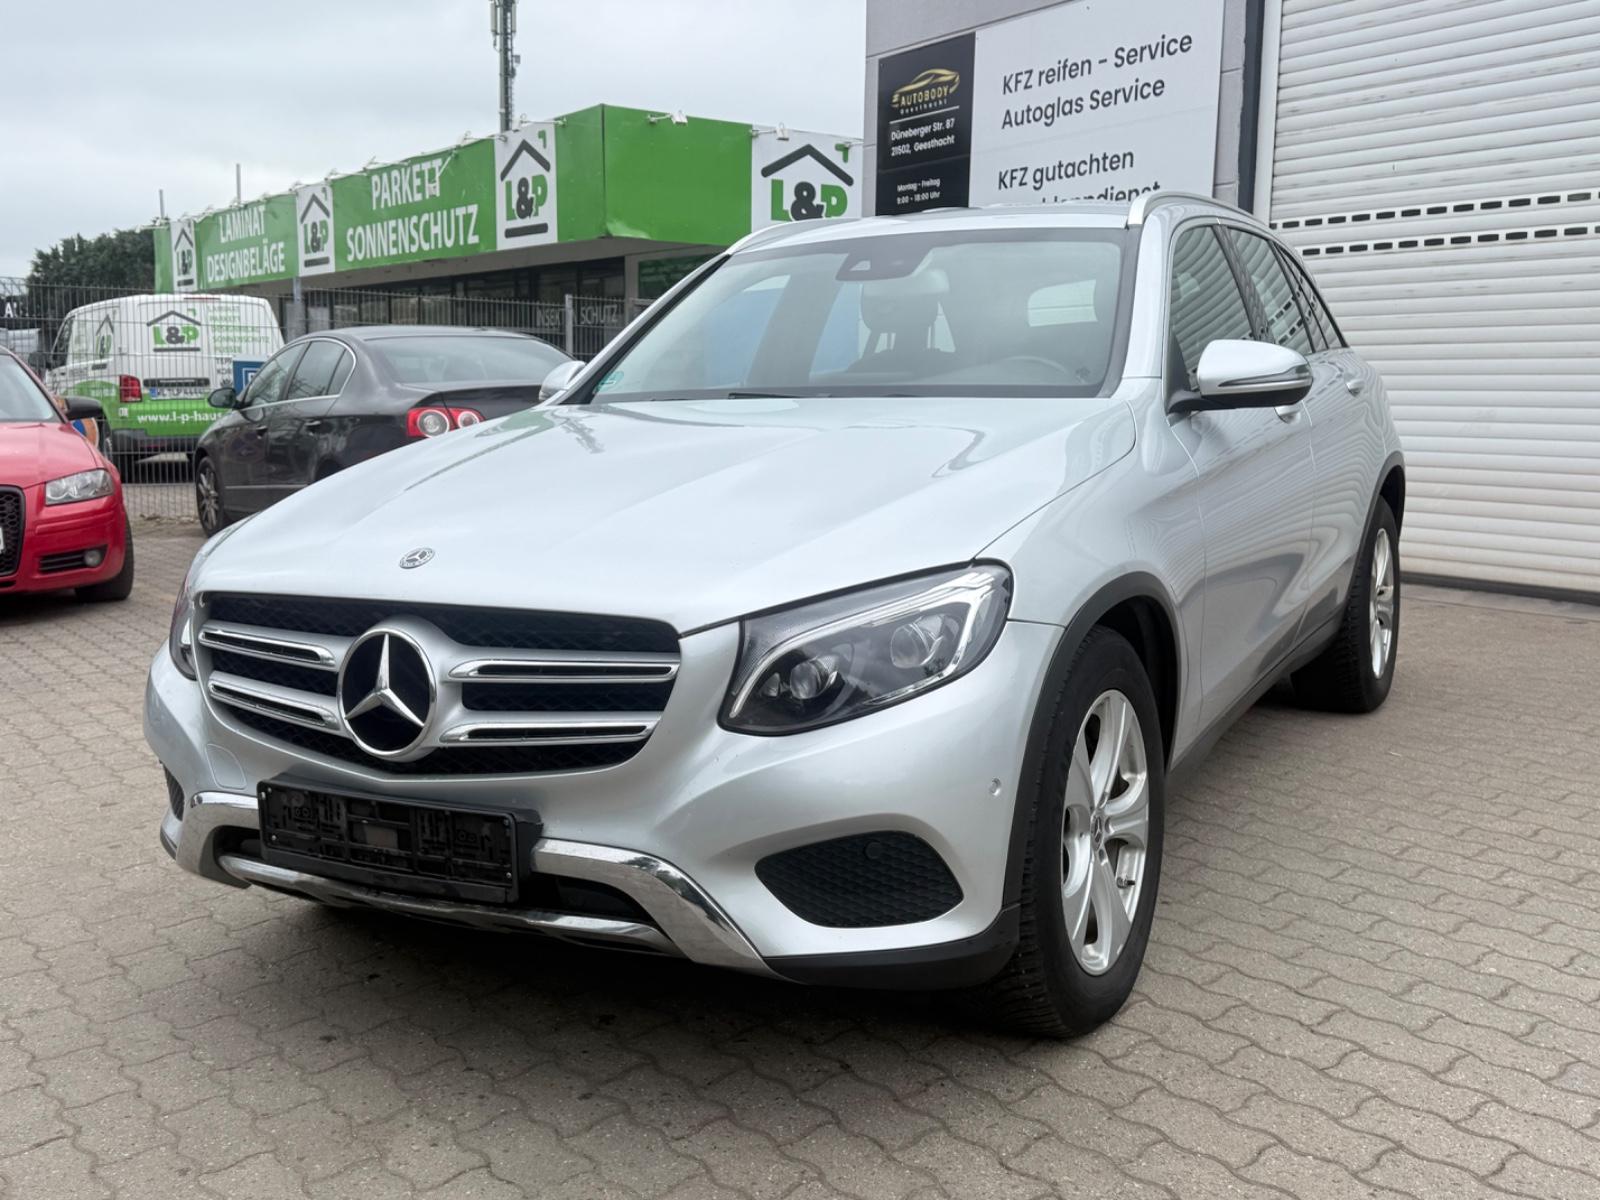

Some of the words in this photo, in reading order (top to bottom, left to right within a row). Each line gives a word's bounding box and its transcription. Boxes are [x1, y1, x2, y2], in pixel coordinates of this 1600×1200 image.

[1003, 69, 1033, 95] KFZ
[1038, 57, 1092, 87] reifen
[1098, 57, 1108, 65] -
[1114, 34, 1192, 68] Service
[900, 86, 949, 107] AUTOBODY
[1001, 97, 1084, 129] Autoglas
[1089, 78, 1165, 110] Service
[891, 125, 932, 141] Düneberger
[932, 120, 944, 132] Str.
[945, 117, 955, 129] 87
[891, 143, 911, 157] 21502,
[913, 134, 955, 152] Geesthacht
[371, 158, 443, 210] PARKETT
[998, 166, 1029, 190] KFZ
[1032, 150, 1134, 191] gutachten
[505, 173, 548, 222] L&P
[771, 178, 848, 222] L&P
[219, 204, 266, 244] LAMINAT
[304, 219, 329, 254] L&P
[346, 204, 480, 262] SONNENSCHUTZ
[206, 238, 286, 283] DESIGNBELÄGE
[153, 323, 199, 345] L&P
